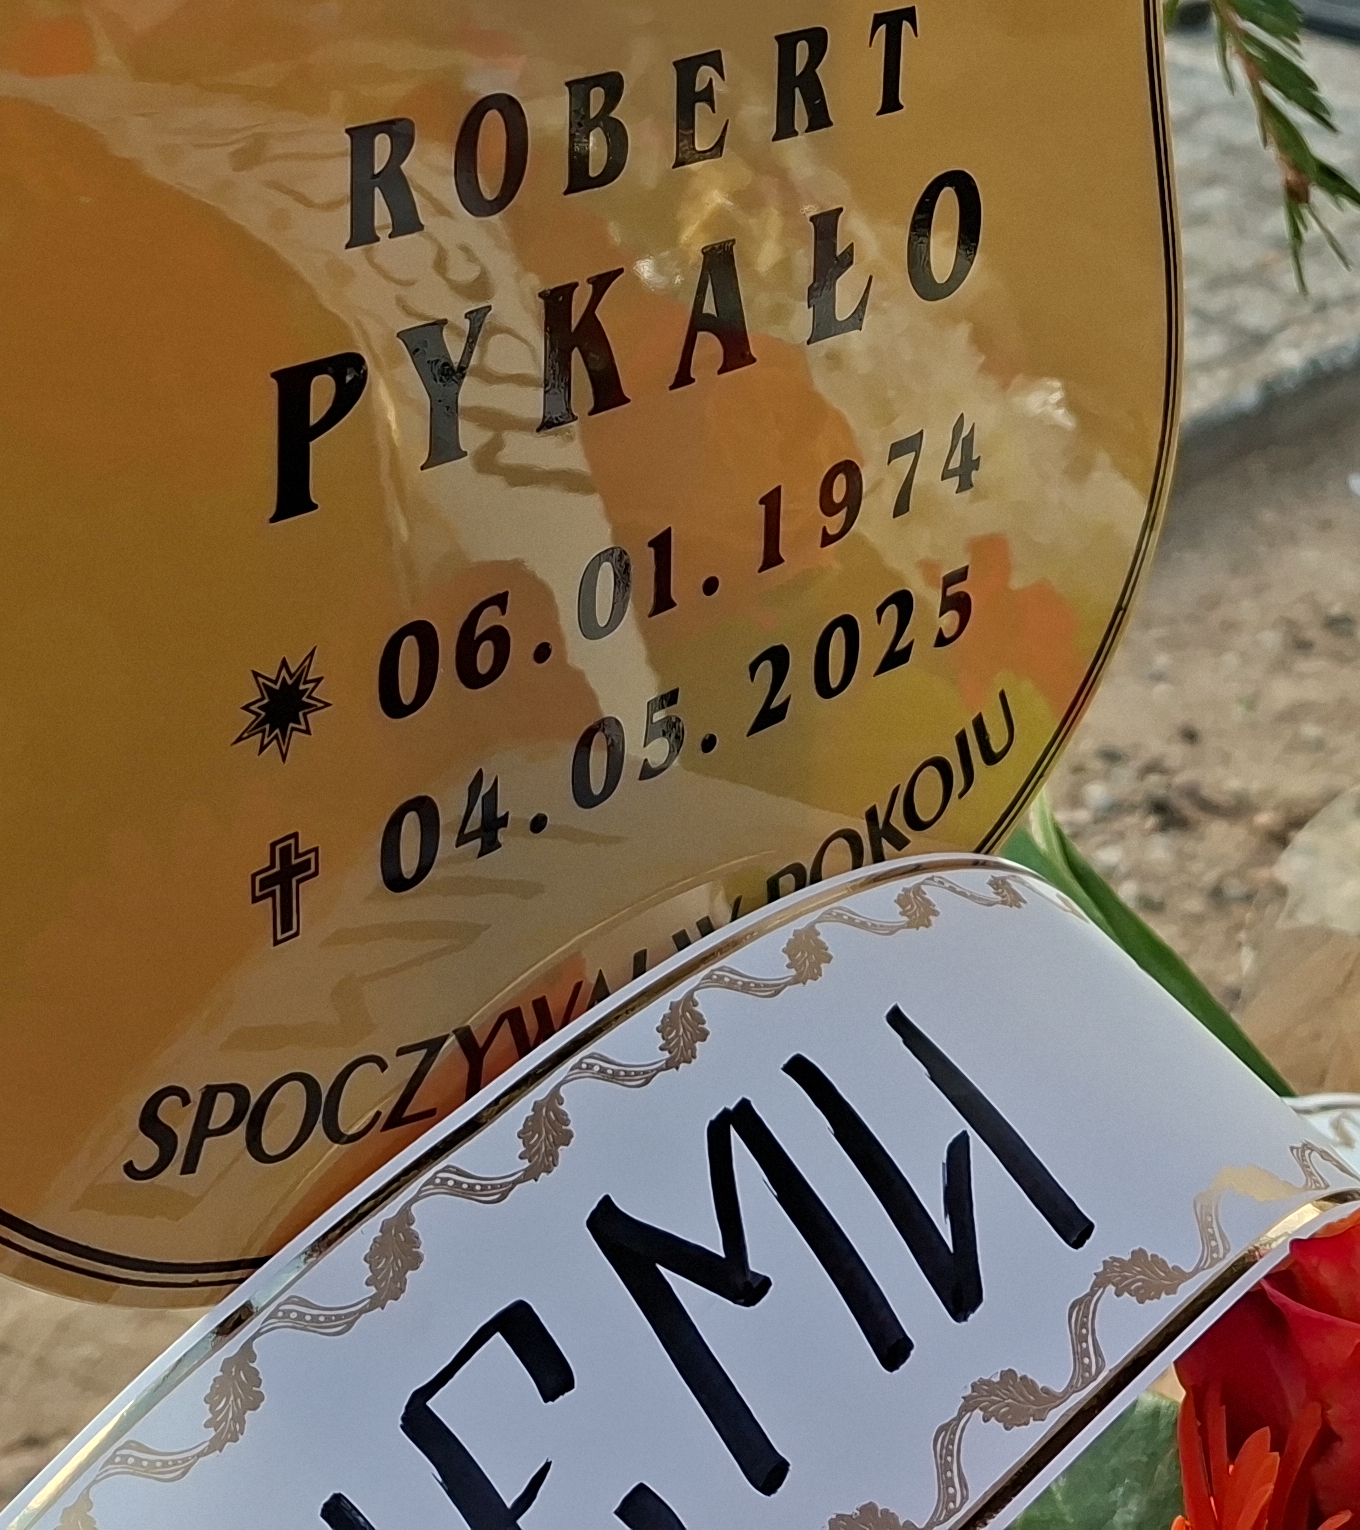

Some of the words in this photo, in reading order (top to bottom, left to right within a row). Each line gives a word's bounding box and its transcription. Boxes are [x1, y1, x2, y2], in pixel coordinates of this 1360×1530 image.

[344, 5, 919, 250] ROBERT
[268, 169, 983, 524] PYKAŁO
[378, 413, 981, 720] 06.01.1974
[380, 565, 973, 893] 04.05.2025
